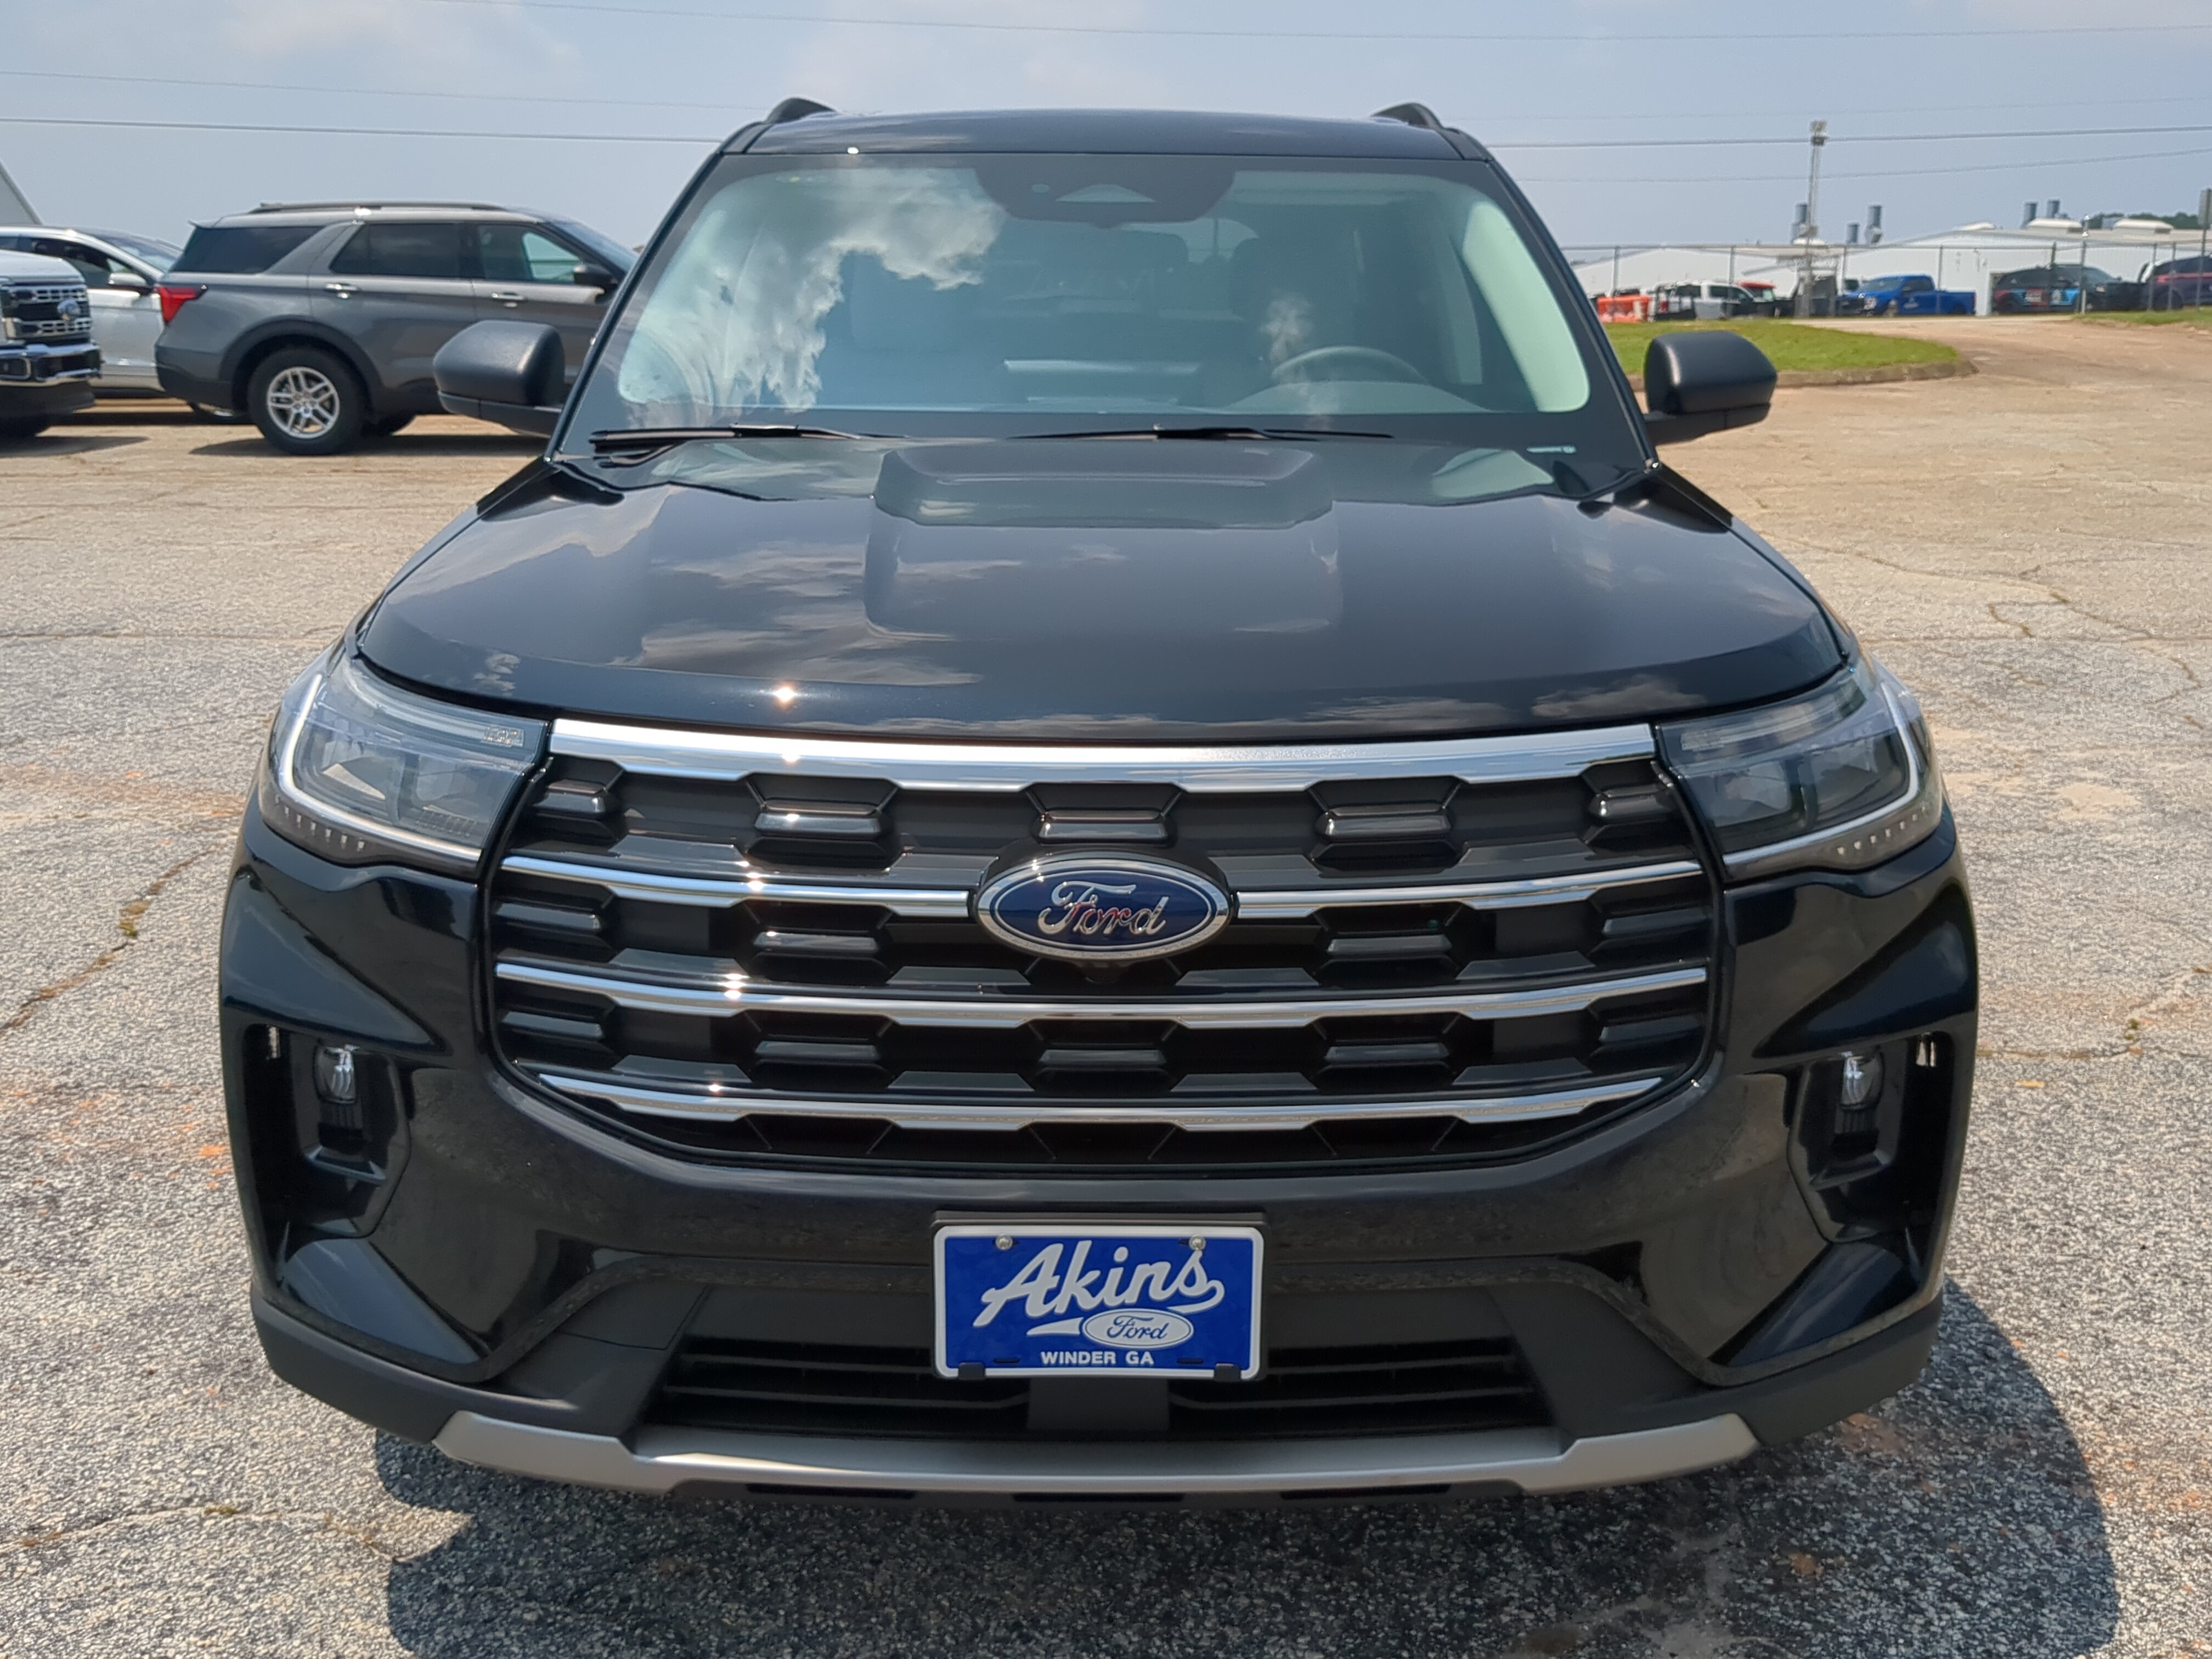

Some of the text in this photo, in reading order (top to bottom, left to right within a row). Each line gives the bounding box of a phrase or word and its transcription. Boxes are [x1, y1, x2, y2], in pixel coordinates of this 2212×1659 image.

[1037, 881, 1169, 935] Ford
[973, 1240, 1224, 1327] Akins
[1107, 1316, 1170, 1340] Ford
[1041, 1351, 1154, 1364] WINDER GA
